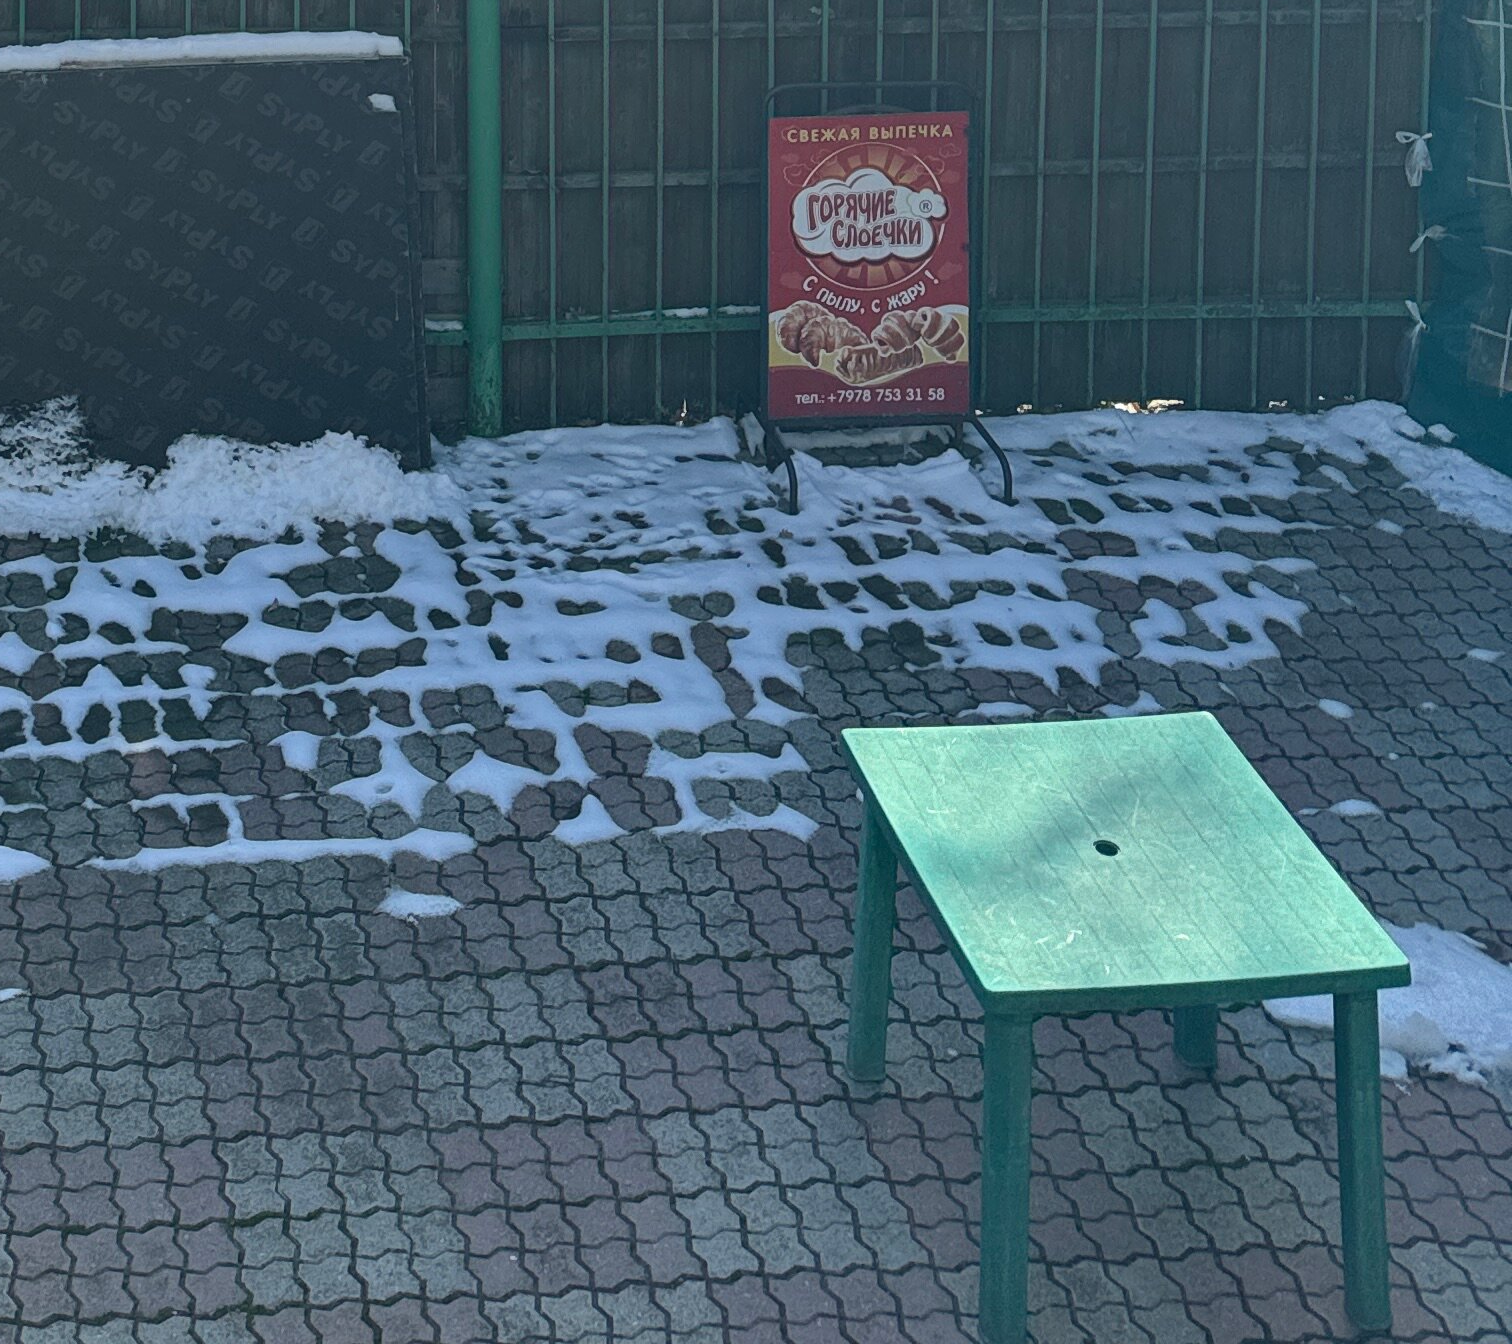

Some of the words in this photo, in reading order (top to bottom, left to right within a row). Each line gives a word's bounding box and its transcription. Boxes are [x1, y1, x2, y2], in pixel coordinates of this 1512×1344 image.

[787, 127, 861, 143] СВЕЖАЯ
[869, 124, 954, 141] ВЫПЕЧКА
[807, 189, 897, 232] ГОРЯЧИЕ
[831, 218, 923, 249] СЛОЕЧКИ
[816, 288, 865, 315] пылу,
[827, 389, 872, 403] +7978
[876, 387, 902, 402] 753
[906, 387, 923, 402] 31
[928, 387, 945, 402] 58
